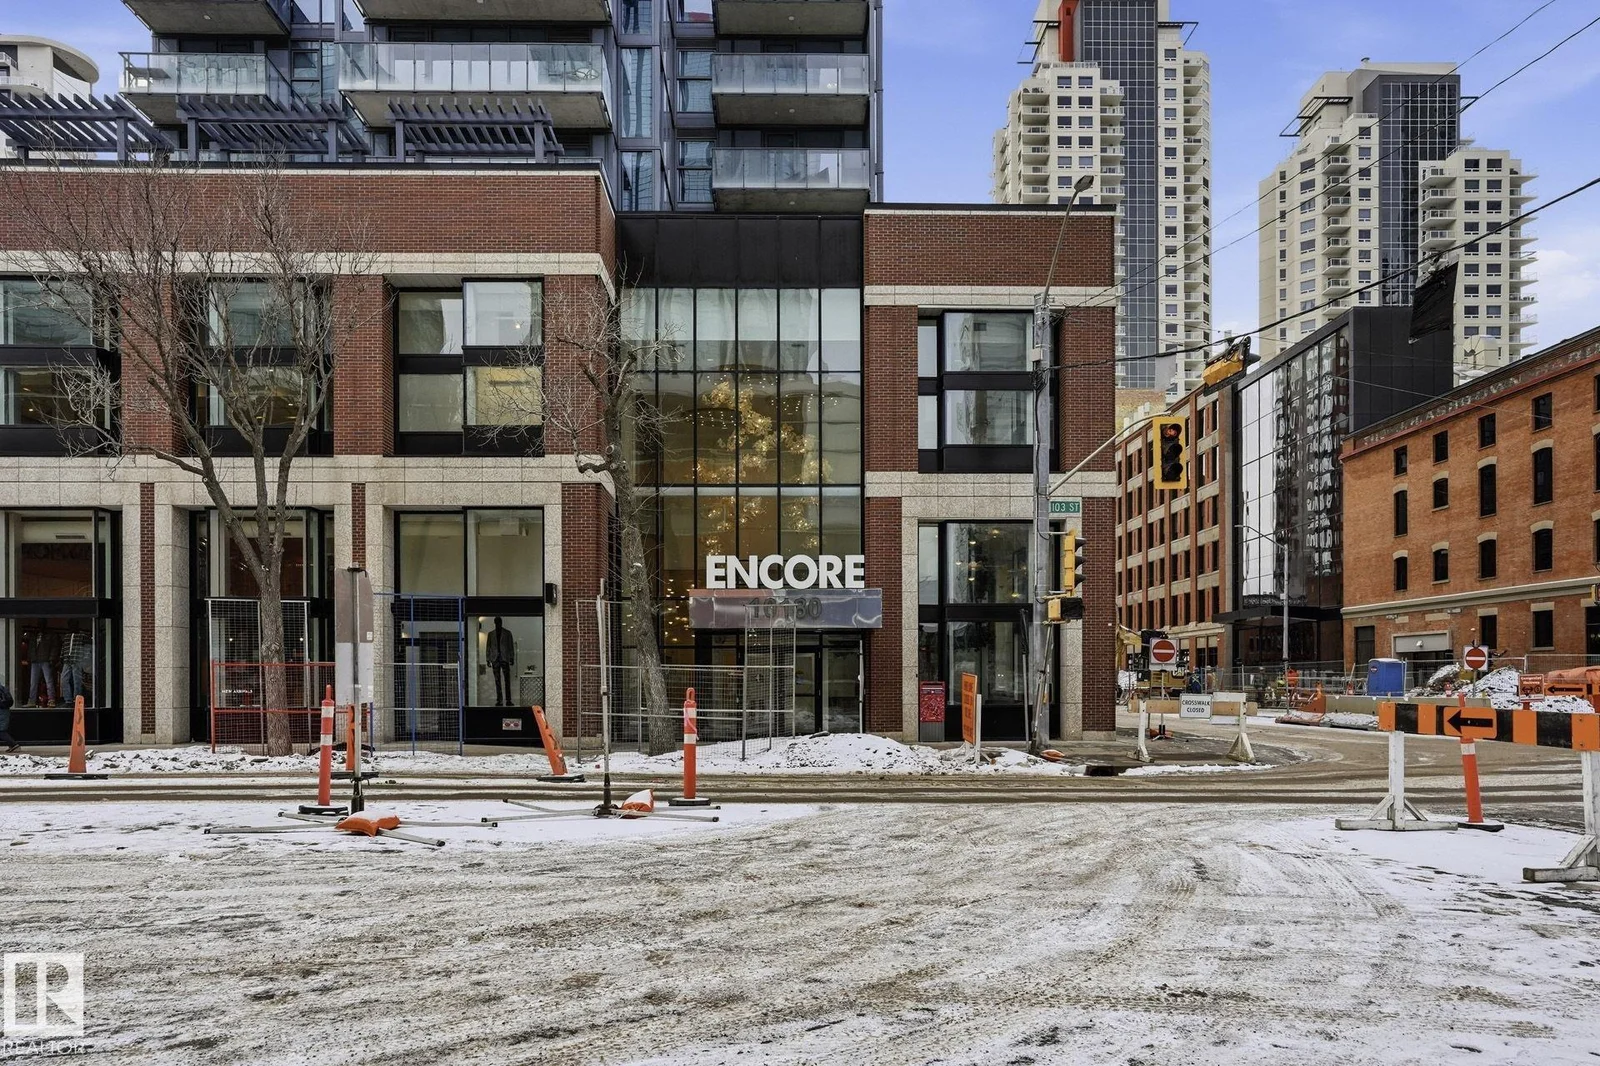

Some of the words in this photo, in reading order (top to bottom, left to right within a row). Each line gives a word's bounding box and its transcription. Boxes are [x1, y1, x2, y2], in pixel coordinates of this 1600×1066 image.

[1052, 502, 1066, 511] 103
[1069, 502, 1079, 511] ST
[706, 554, 865, 590] ENCORE
